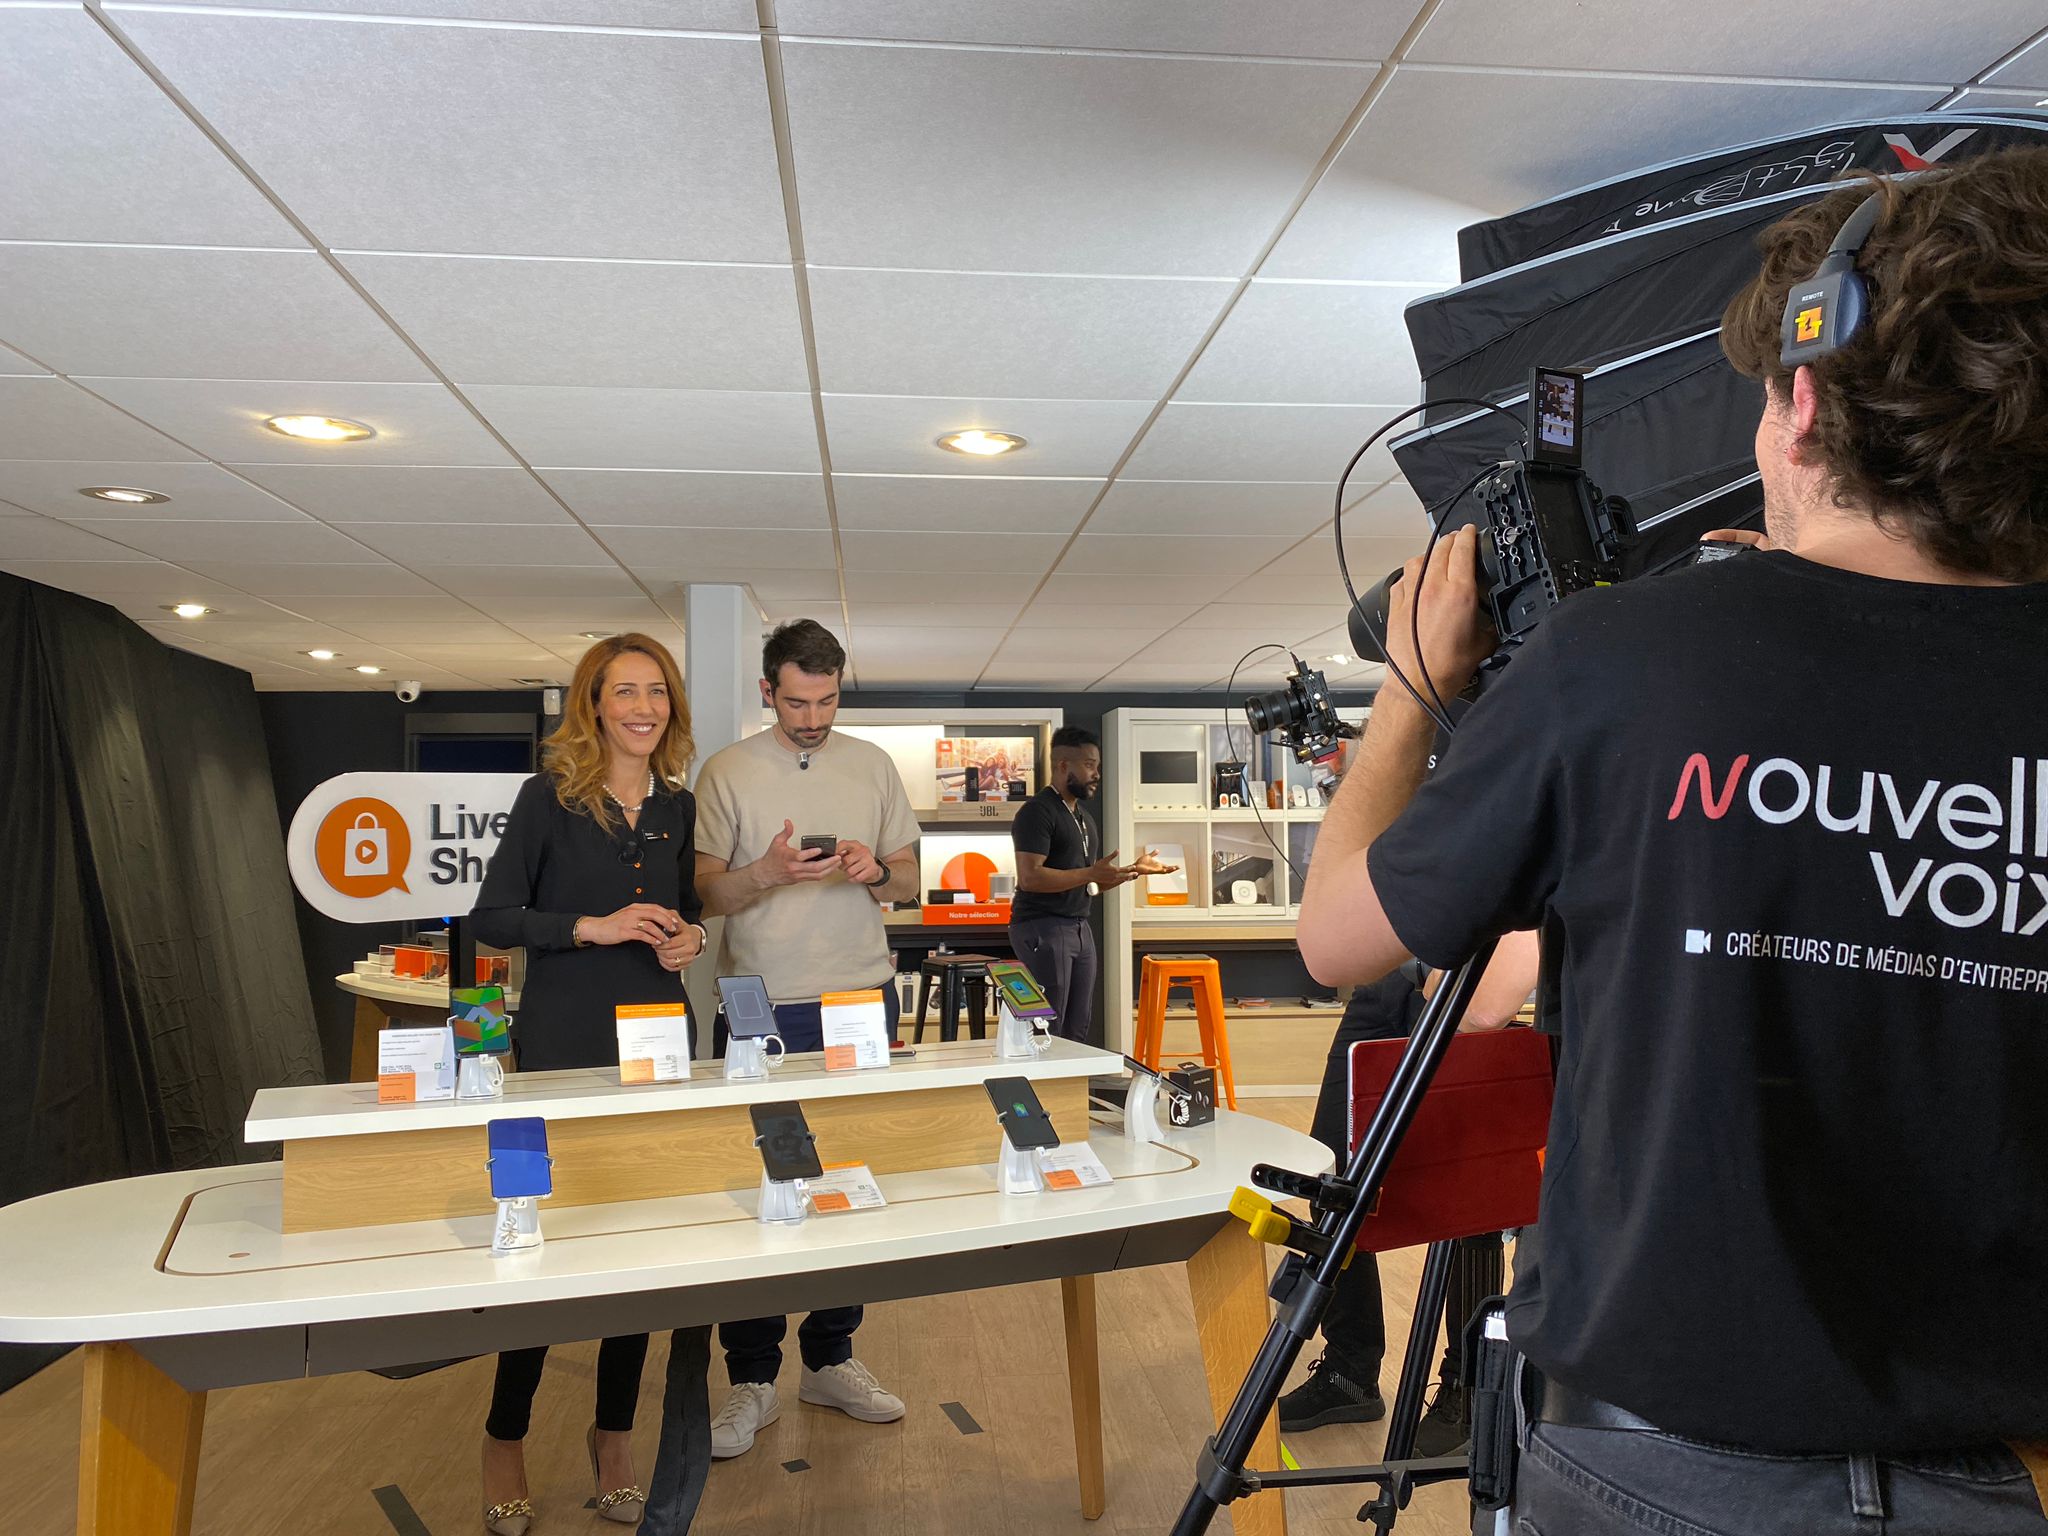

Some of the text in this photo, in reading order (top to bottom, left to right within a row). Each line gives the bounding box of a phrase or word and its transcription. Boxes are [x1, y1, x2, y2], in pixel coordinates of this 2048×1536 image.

[430, 803, 510, 840] Live
[980, 805, 999, 817] JBL
[429, 847, 494, 885] Sh
[969, 911, 1000, 919] sélection
[1726, 930, 2048, 993] CRÉATEURS DE MÉDIAS D'ENTREPR
